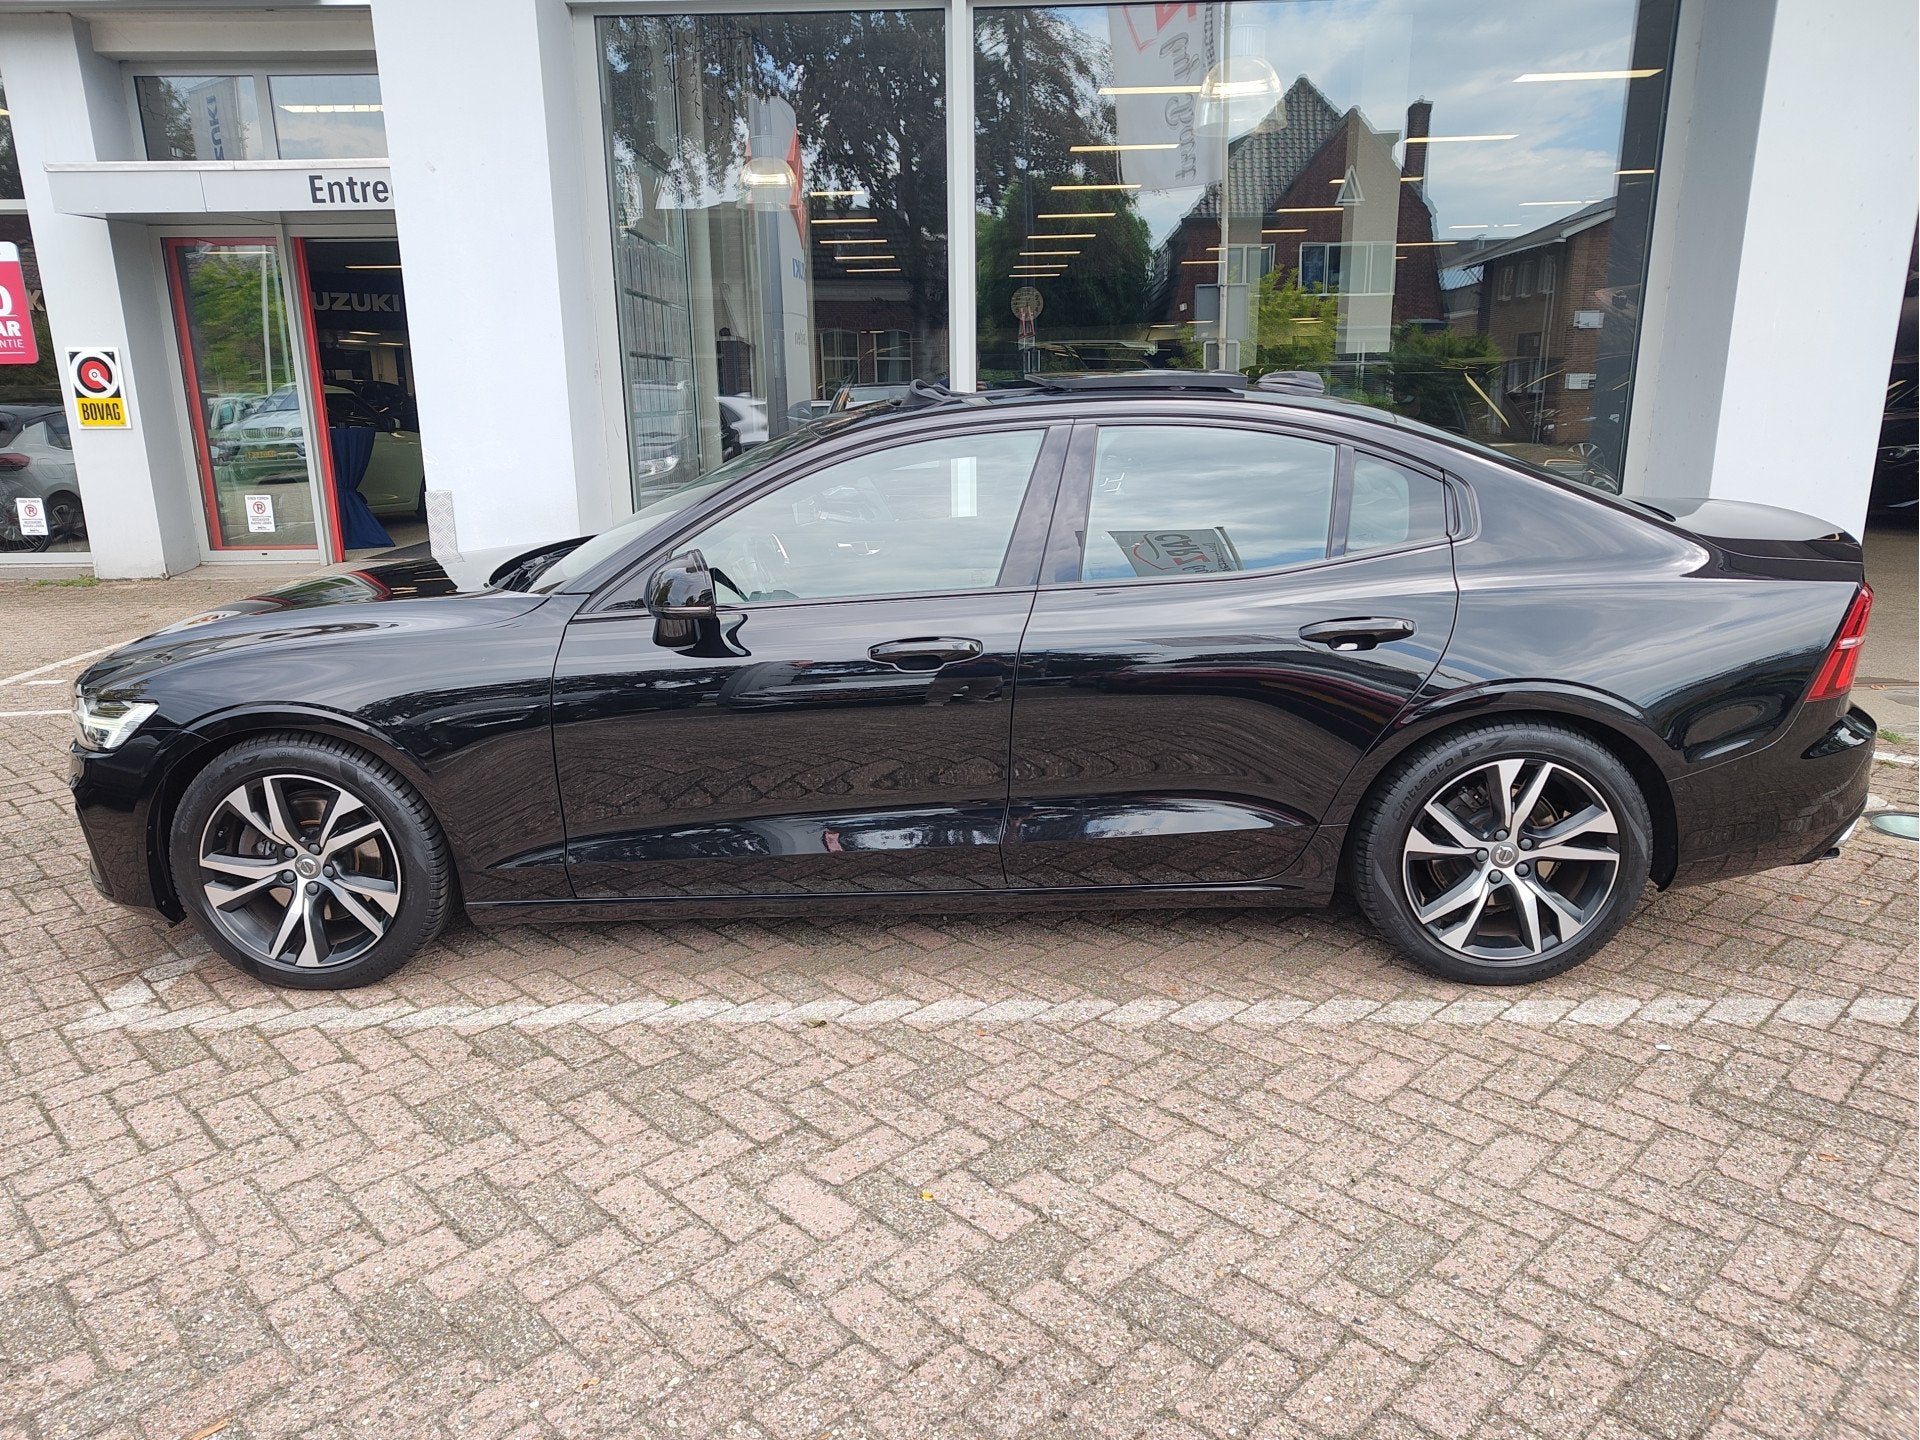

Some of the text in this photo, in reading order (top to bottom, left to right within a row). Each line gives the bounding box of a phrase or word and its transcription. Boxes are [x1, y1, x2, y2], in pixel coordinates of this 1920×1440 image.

[308, 175, 394, 204] Entre
[312, 291, 401, 312] UZUKI
[81, 402, 121, 421] BOVAG
